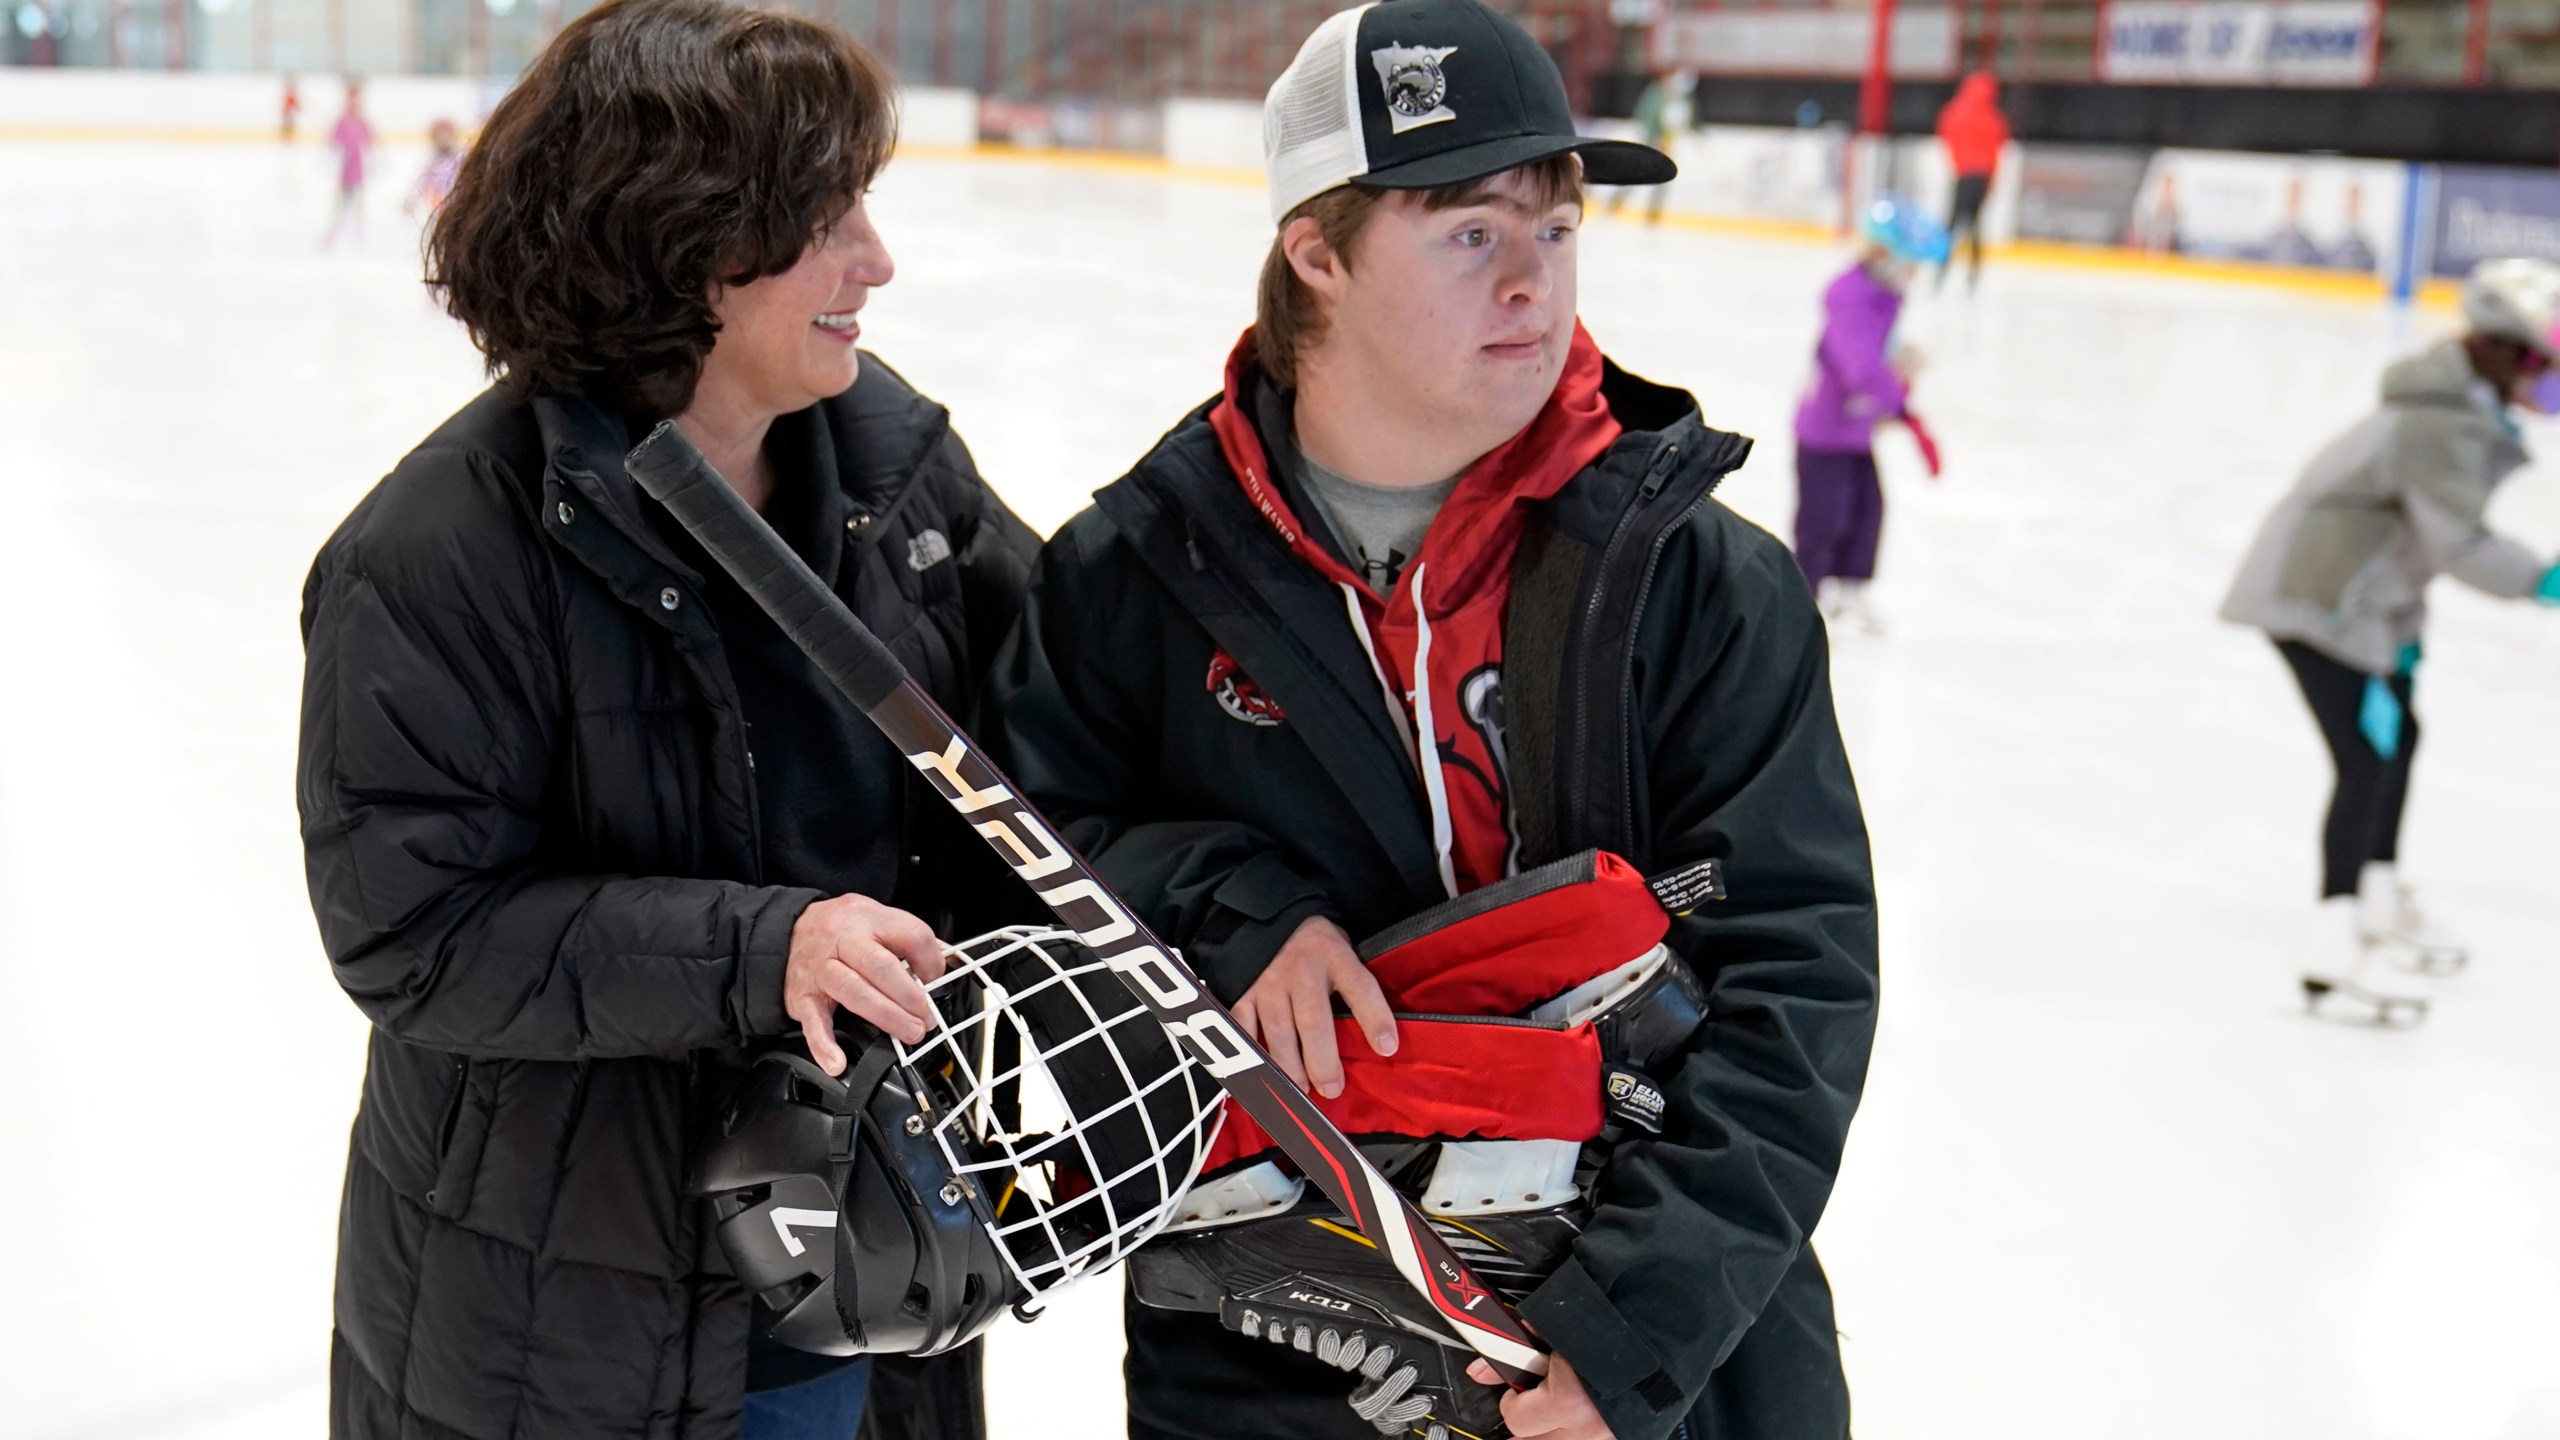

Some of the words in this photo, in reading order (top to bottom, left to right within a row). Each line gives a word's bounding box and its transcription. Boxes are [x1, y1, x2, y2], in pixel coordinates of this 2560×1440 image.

[907, 733, 1264, 1079] BAUER
[1440, 1261, 1459, 1282] LITE
[1289, 1291, 1351, 1311] CCM
